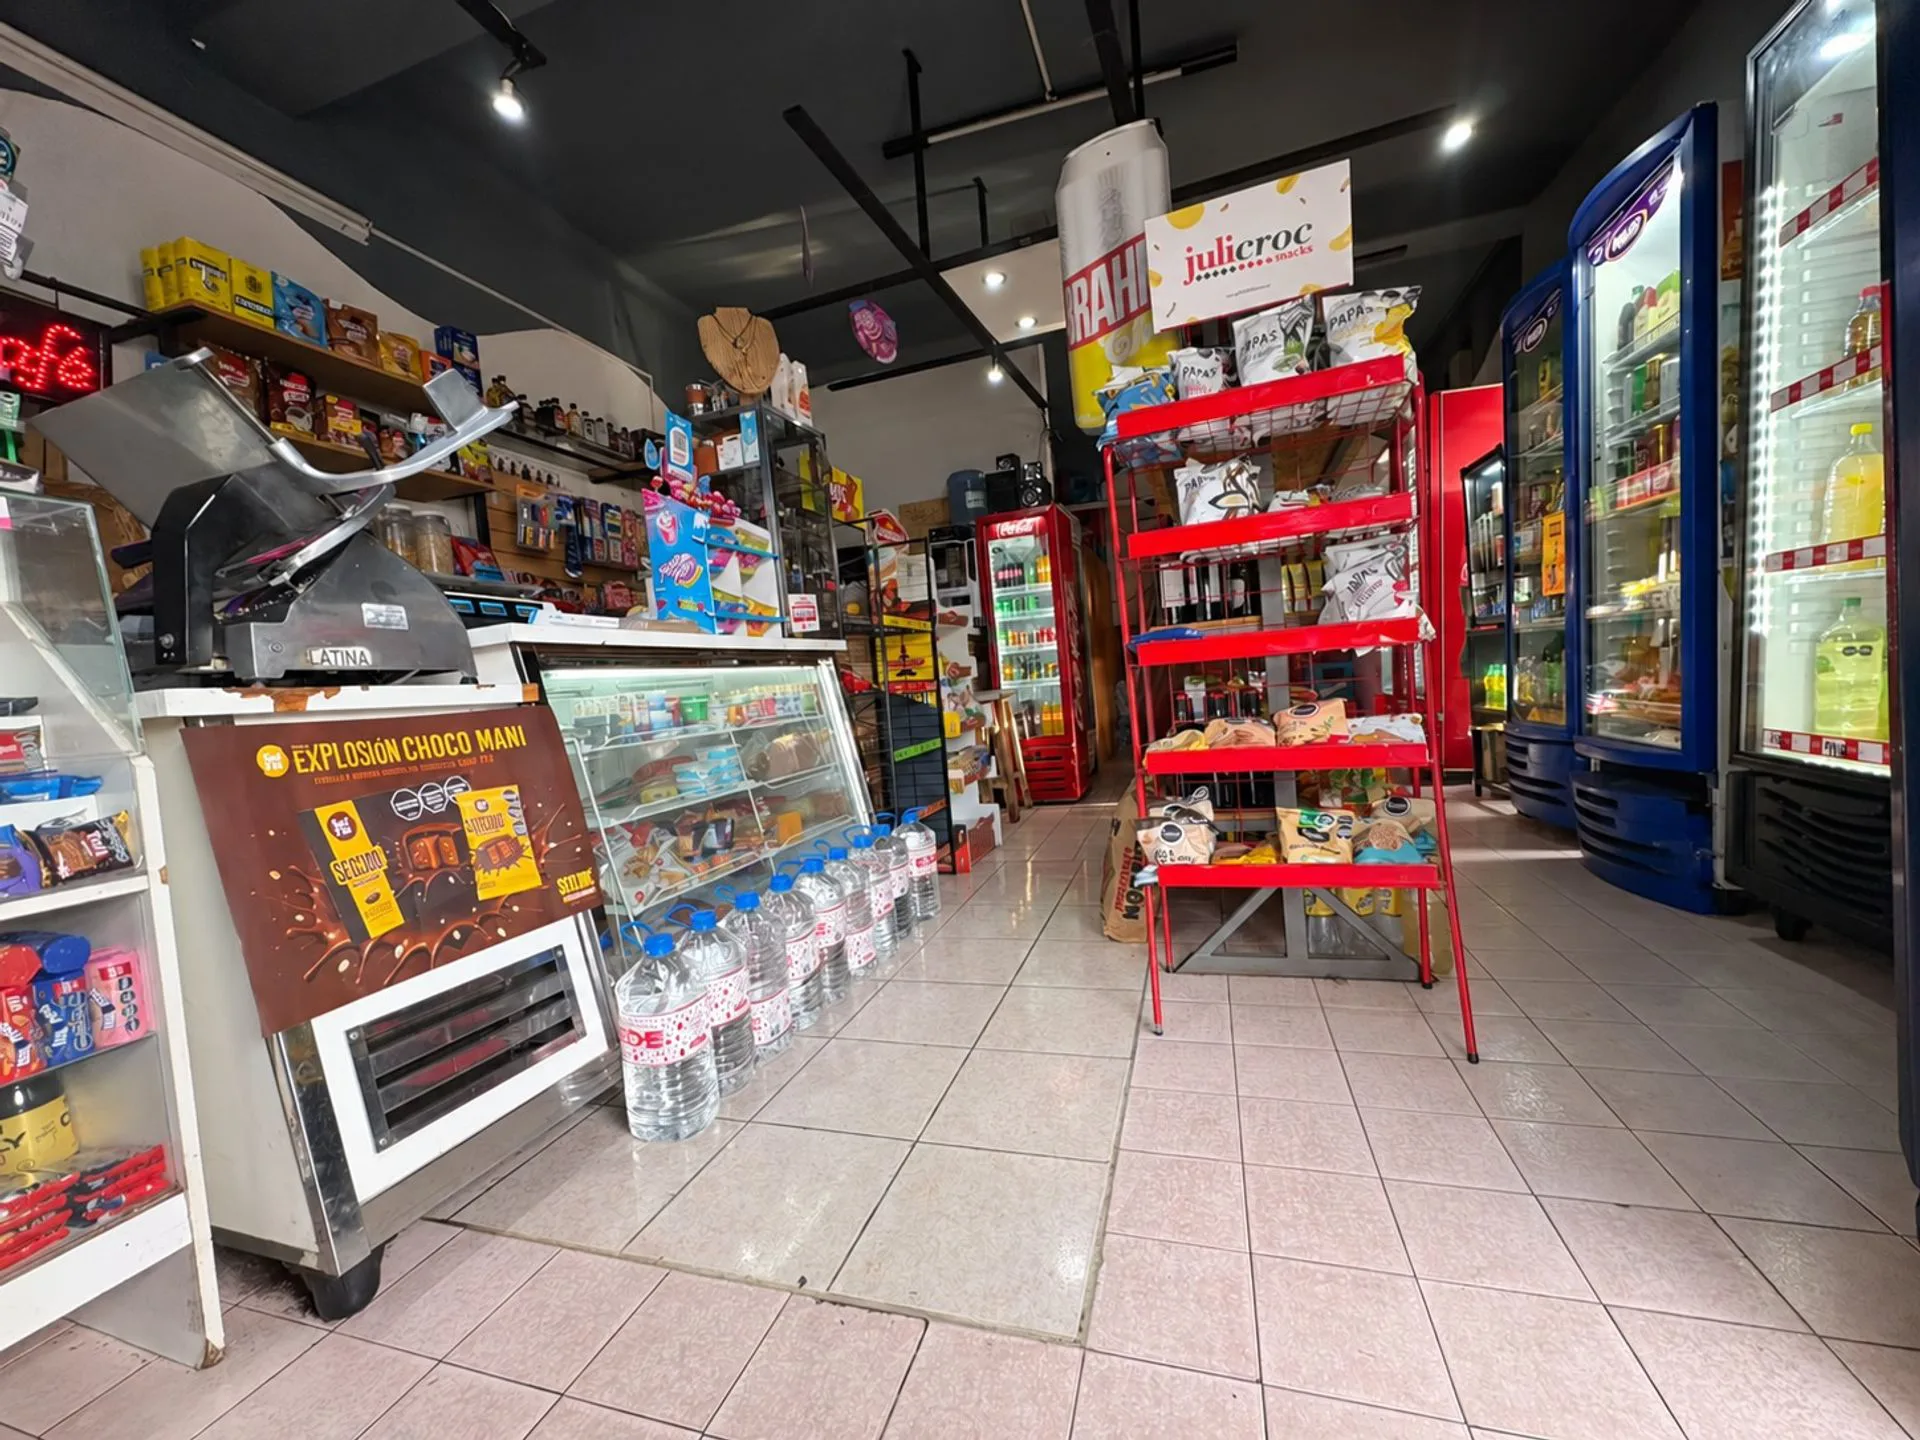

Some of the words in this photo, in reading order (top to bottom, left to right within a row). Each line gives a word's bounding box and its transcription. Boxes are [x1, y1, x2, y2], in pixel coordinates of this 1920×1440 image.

[1183, 223, 1313, 286] julicroc
[1274, 245, 1313, 262] snacks
[1182, 366, 1217, 379] PAPAS
[309, 648, 371, 666] LATINA
[292, 737, 402, 774] EXPLOSIÓN
[402, 731, 472, 761] CHOCO
[475, 725, 528, 752] MANI
